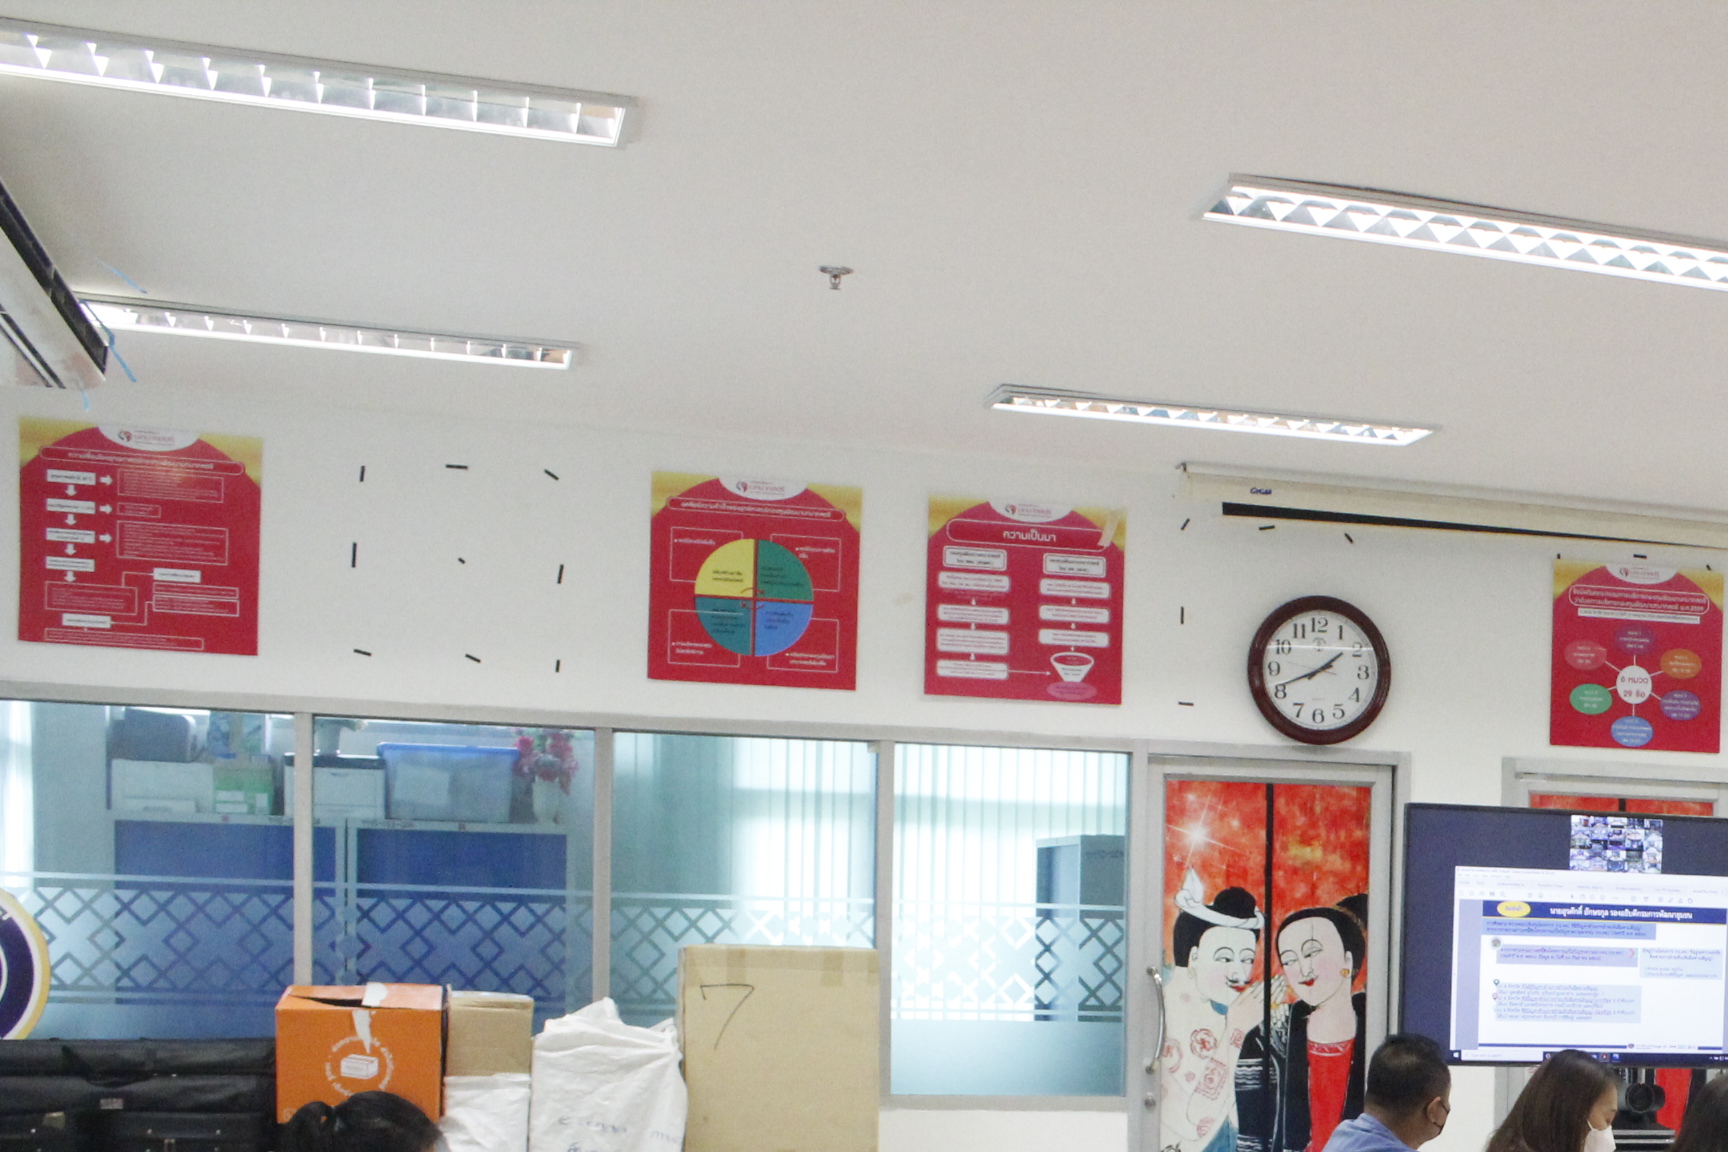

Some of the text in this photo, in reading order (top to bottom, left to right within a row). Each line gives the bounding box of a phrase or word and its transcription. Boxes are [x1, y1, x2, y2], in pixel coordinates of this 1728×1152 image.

[1003, 528, 1057, 543] ความเป็นมา
[1293, 623, 1305, 639] 11
[1311, 617, 1328, 633] 12
[1338, 625, 1343, 640] 1
[1276, 639, 1292, 655] 10
[1352, 642, 1363, 657] 2
[1268, 661, 1280, 676] 9
[1357, 665, 1370, 680] 3
[1628, 676, 1649, 685] หมวด
[1274, 684, 1287, 699] 8
[1348, 687, 1360, 702] 4
[1623, 689, 1646, 698] 29 ข้อ
[1293, 703, 1305, 718] 7
[1312, 708, 1325, 724] 6
[1333, 704, 1345, 719] 5
